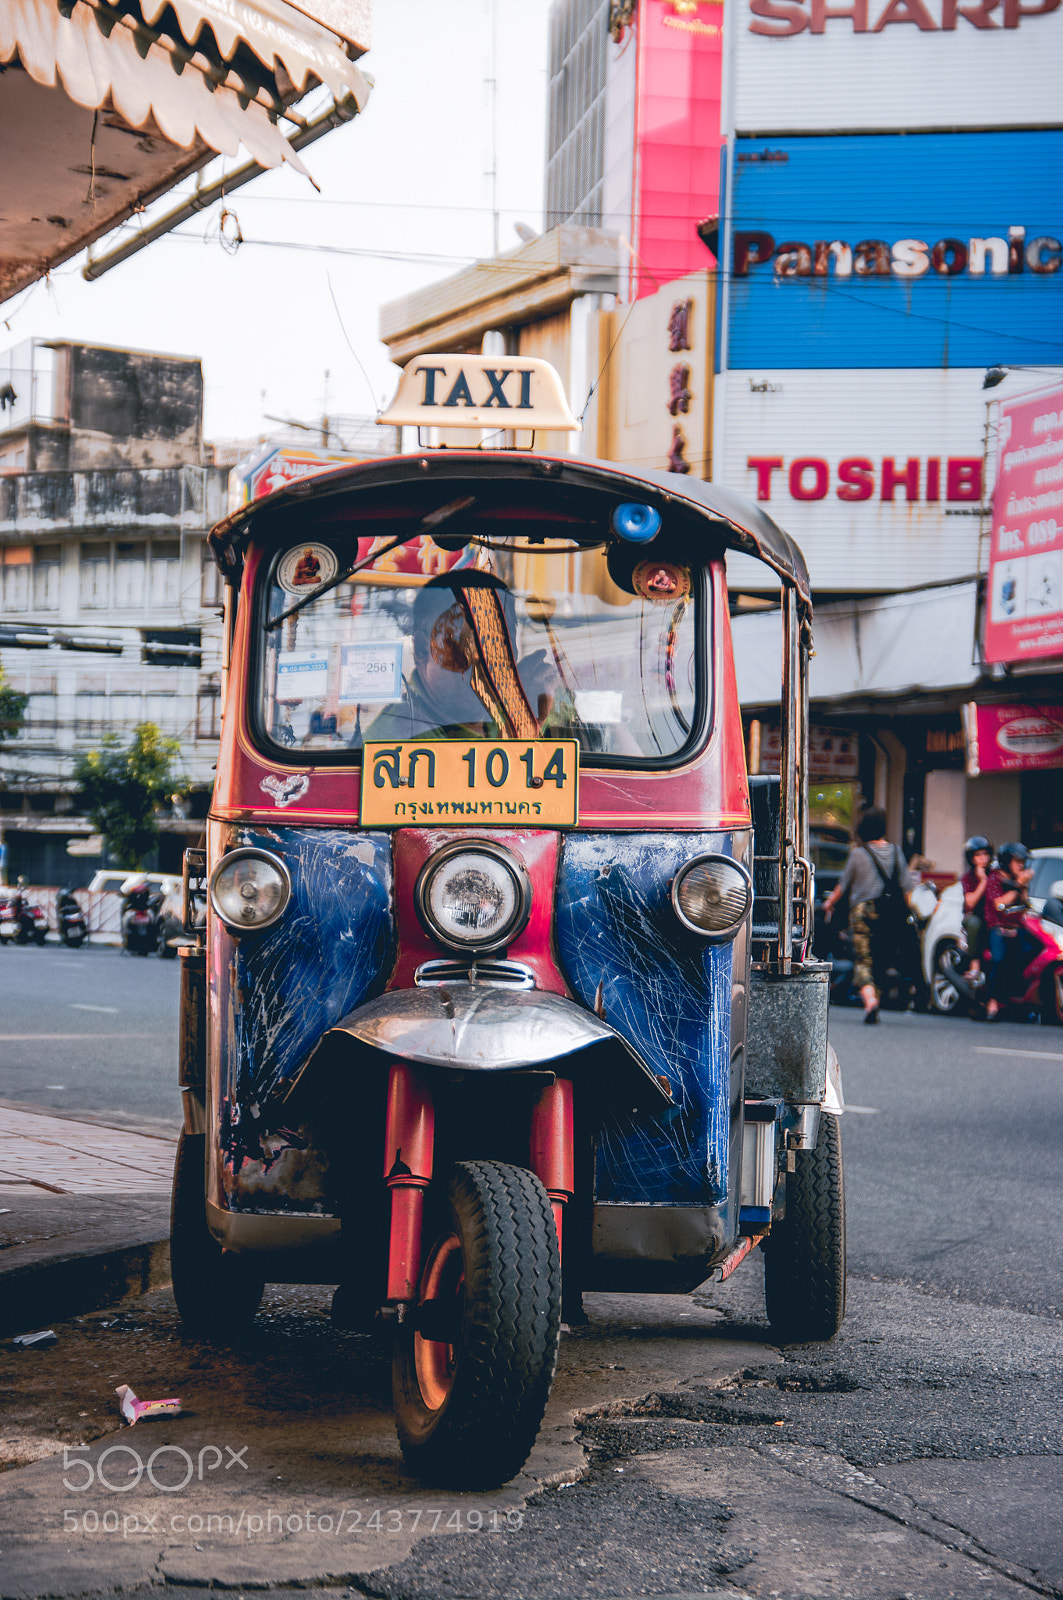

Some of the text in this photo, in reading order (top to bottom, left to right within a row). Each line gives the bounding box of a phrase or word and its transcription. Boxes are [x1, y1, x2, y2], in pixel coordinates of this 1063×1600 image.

[748, 0, 1062, 37] SHARP
[732, 225, 1063, 278] Panasonic
[414, 366, 535, 409] TAXI
[747, 455, 988, 502] TOSHIB
[366, 662, 395, 673] 2561
[373, 745, 567, 789] สก 1014
[394, 801, 542, 821] กรุงเทพมหานคร
